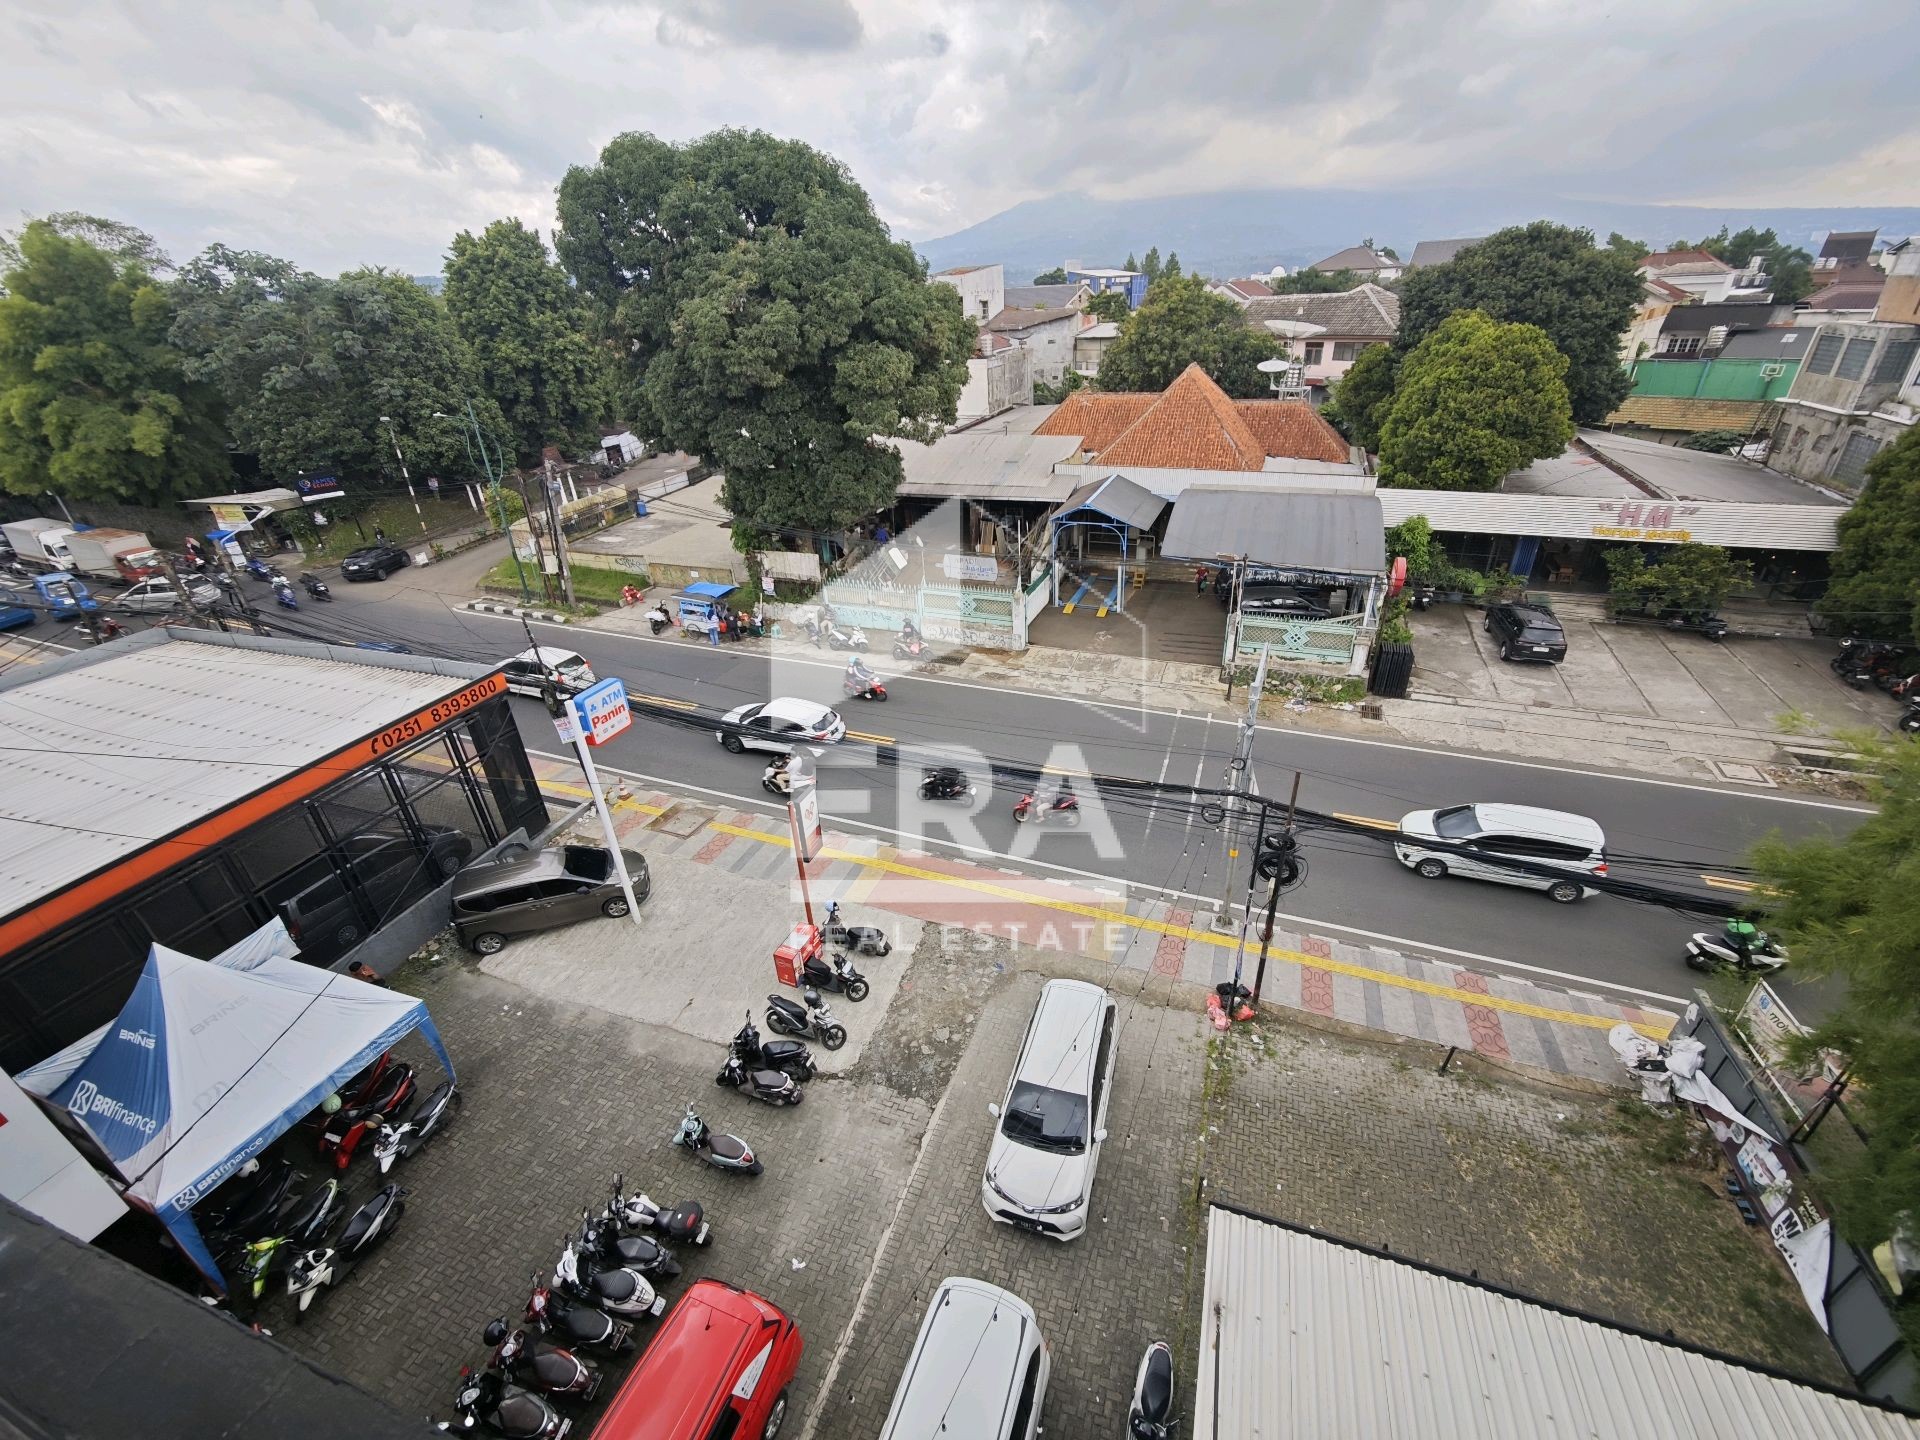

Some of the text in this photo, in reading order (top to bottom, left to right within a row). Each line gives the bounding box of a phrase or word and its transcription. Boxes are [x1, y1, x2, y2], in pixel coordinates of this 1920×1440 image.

[382, 679, 497, 748] 0251 8393800
[601, 688, 623, 708] ATM
[591, 703, 626, 730] Panin
[119, 1028, 156, 1050] BRINS
[90, 1093, 157, 1134] BRIfinance
[196, 1136, 265, 1192] BRIfinance
